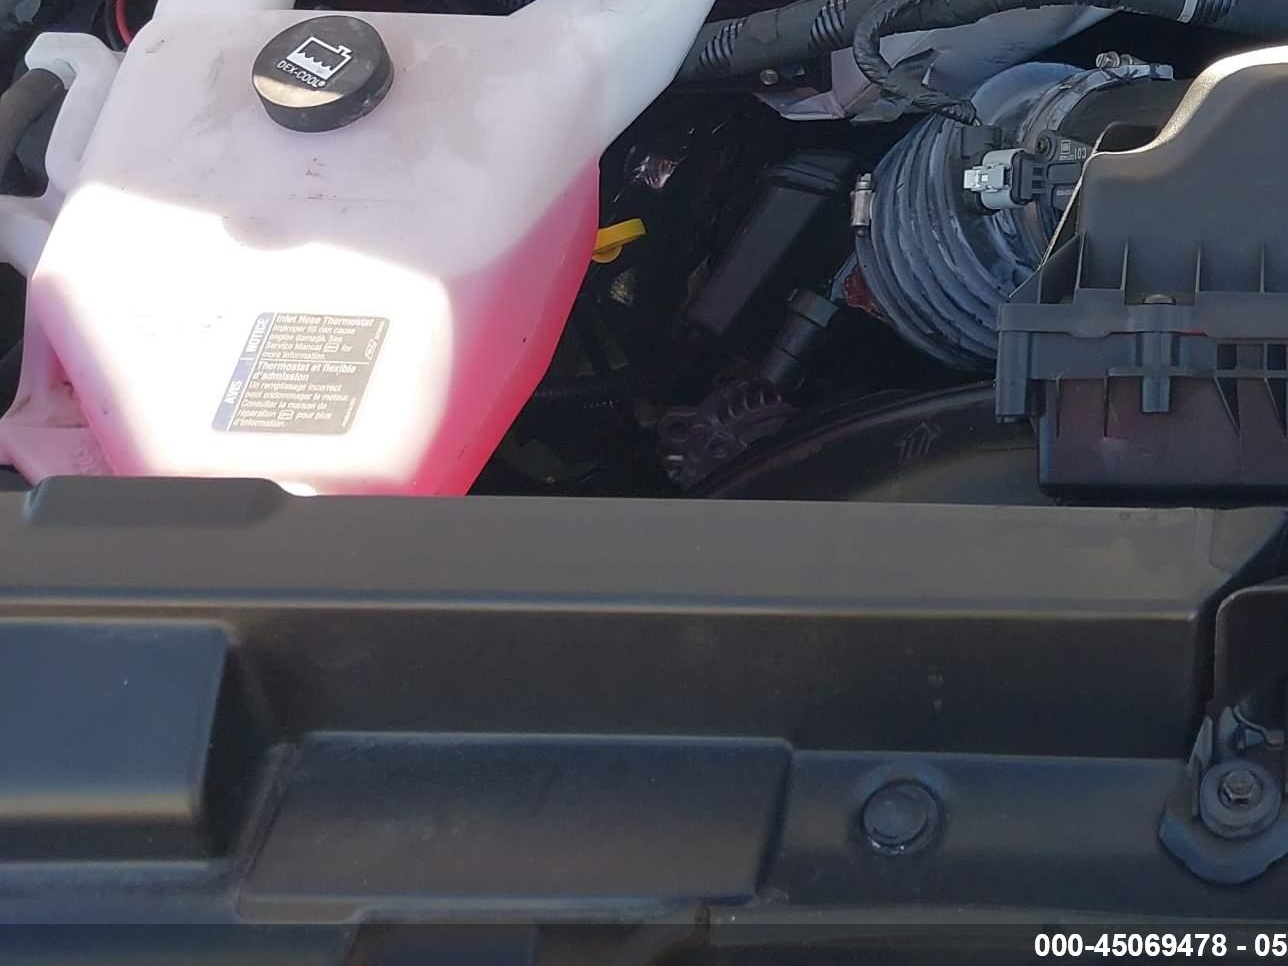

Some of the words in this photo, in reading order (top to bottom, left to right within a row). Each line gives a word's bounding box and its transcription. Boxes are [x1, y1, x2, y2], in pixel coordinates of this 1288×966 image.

[276, 314, 296, 324] Inlet
[323, 316, 374, 327] Thermostat
[246, 317, 270, 353] NOTICE
[273, 324, 307, 334] Improper
[333, 327, 356, 335] cause
[269, 334, 294, 342] engine
[328, 335, 343, 343] See
[265, 341, 293, 350] Service
[294, 342, 322, 350] Manual
[341, 344, 352, 352] for
[257, 361, 309, 372] Thermostat
[310, 363, 321, 371] et
[322, 362, 356, 374] flexible
[253, 371, 309, 381] d'admission
[223, 379, 243, 404] AVIS
[308, 383, 342, 392] incorrect
